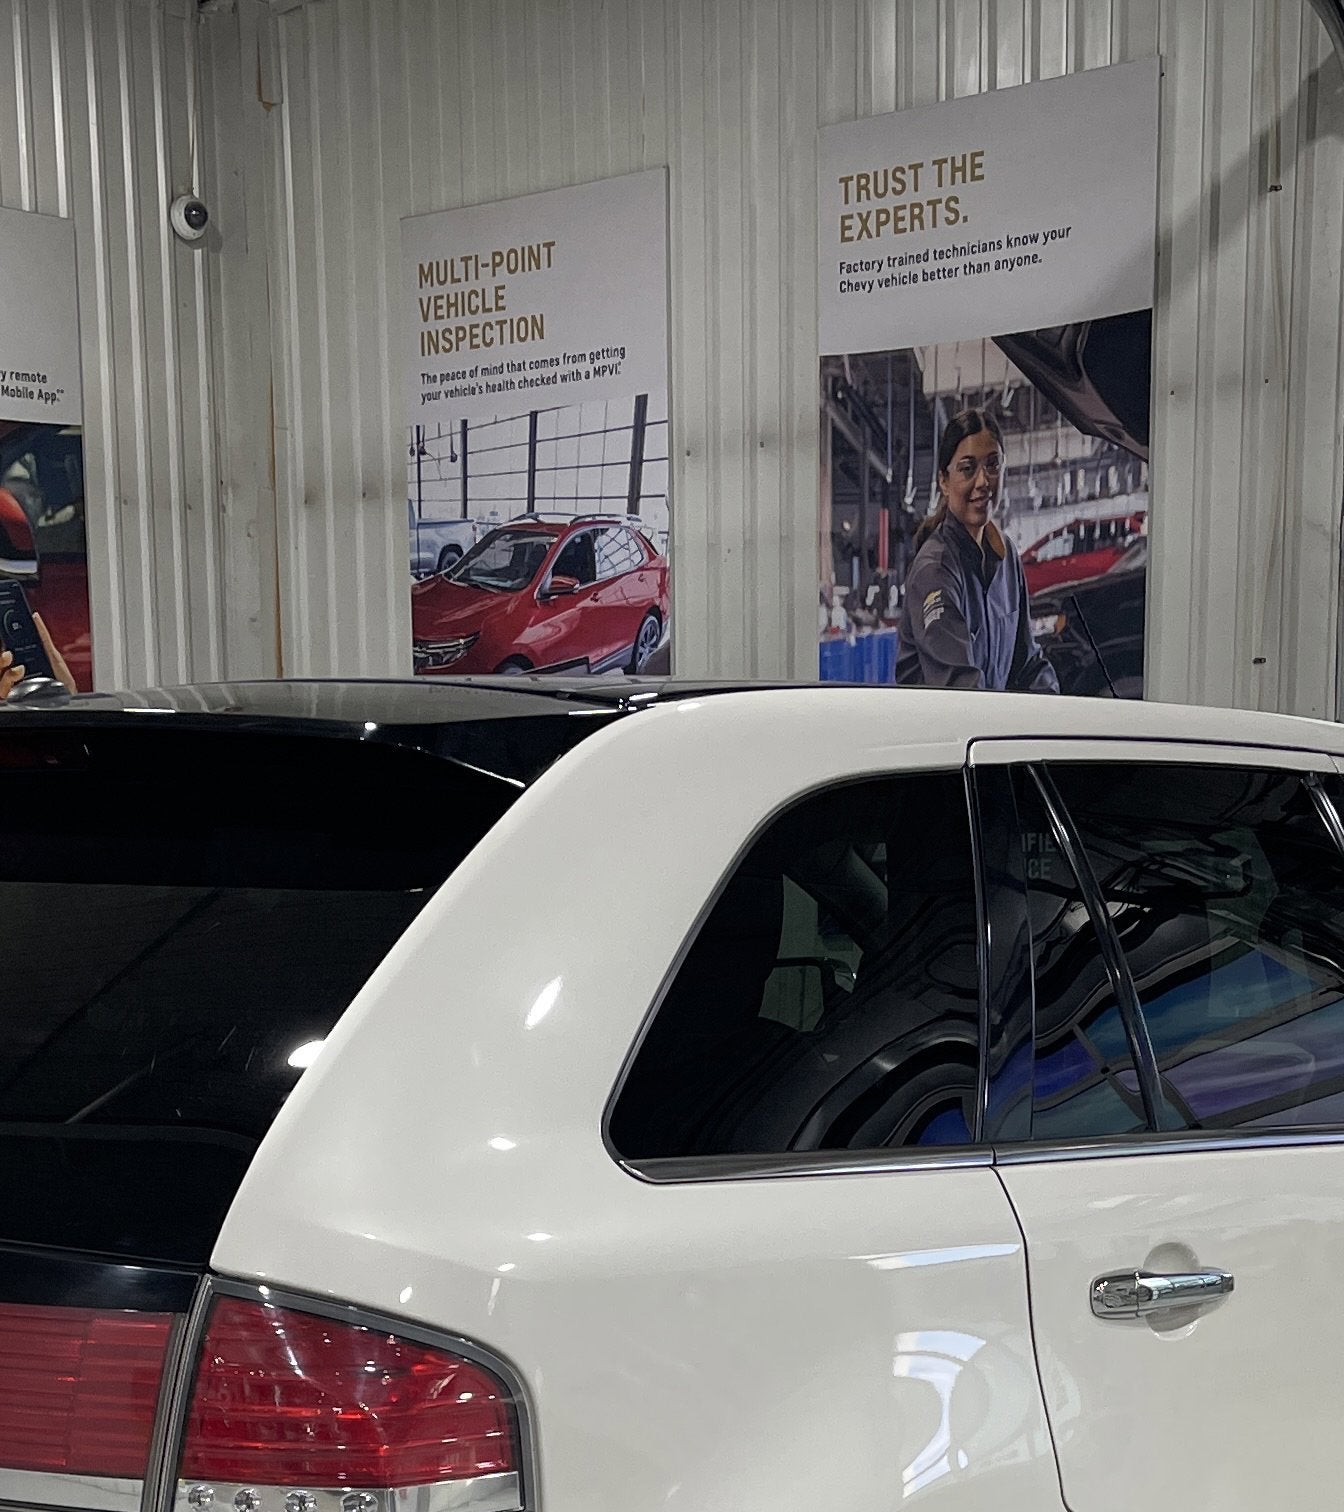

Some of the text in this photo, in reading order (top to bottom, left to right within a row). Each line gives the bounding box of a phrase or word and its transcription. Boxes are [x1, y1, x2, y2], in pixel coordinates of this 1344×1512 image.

[839, 150, 985, 205] TRUST THE
[840, 195, 969, 243] EXPERTS.
[418, 241, 556, 289] MULTI-POINT
[839, 226, 1072, 275] Factory trained technicians know your
[839, 252, 1043, 294] Chevy vehicle better than anyone.
[419, 284, 506, 323] VEHICLE
[420, 313, 545, 357] INSPECTION
[9, 370, 48, 384] remote
[420, 346, 626, 386] The peace of mind that comes from getting
[421, 390, 442, 406] your
[444, 382, 484, 400] vehicle's
[485, 377, 516, 394] health
[517, 371, 558, 389] checked
[560, 368, 583, 383] with
[584, 369, 591, 380] a
[0, 384, 35, 400] Mobile
